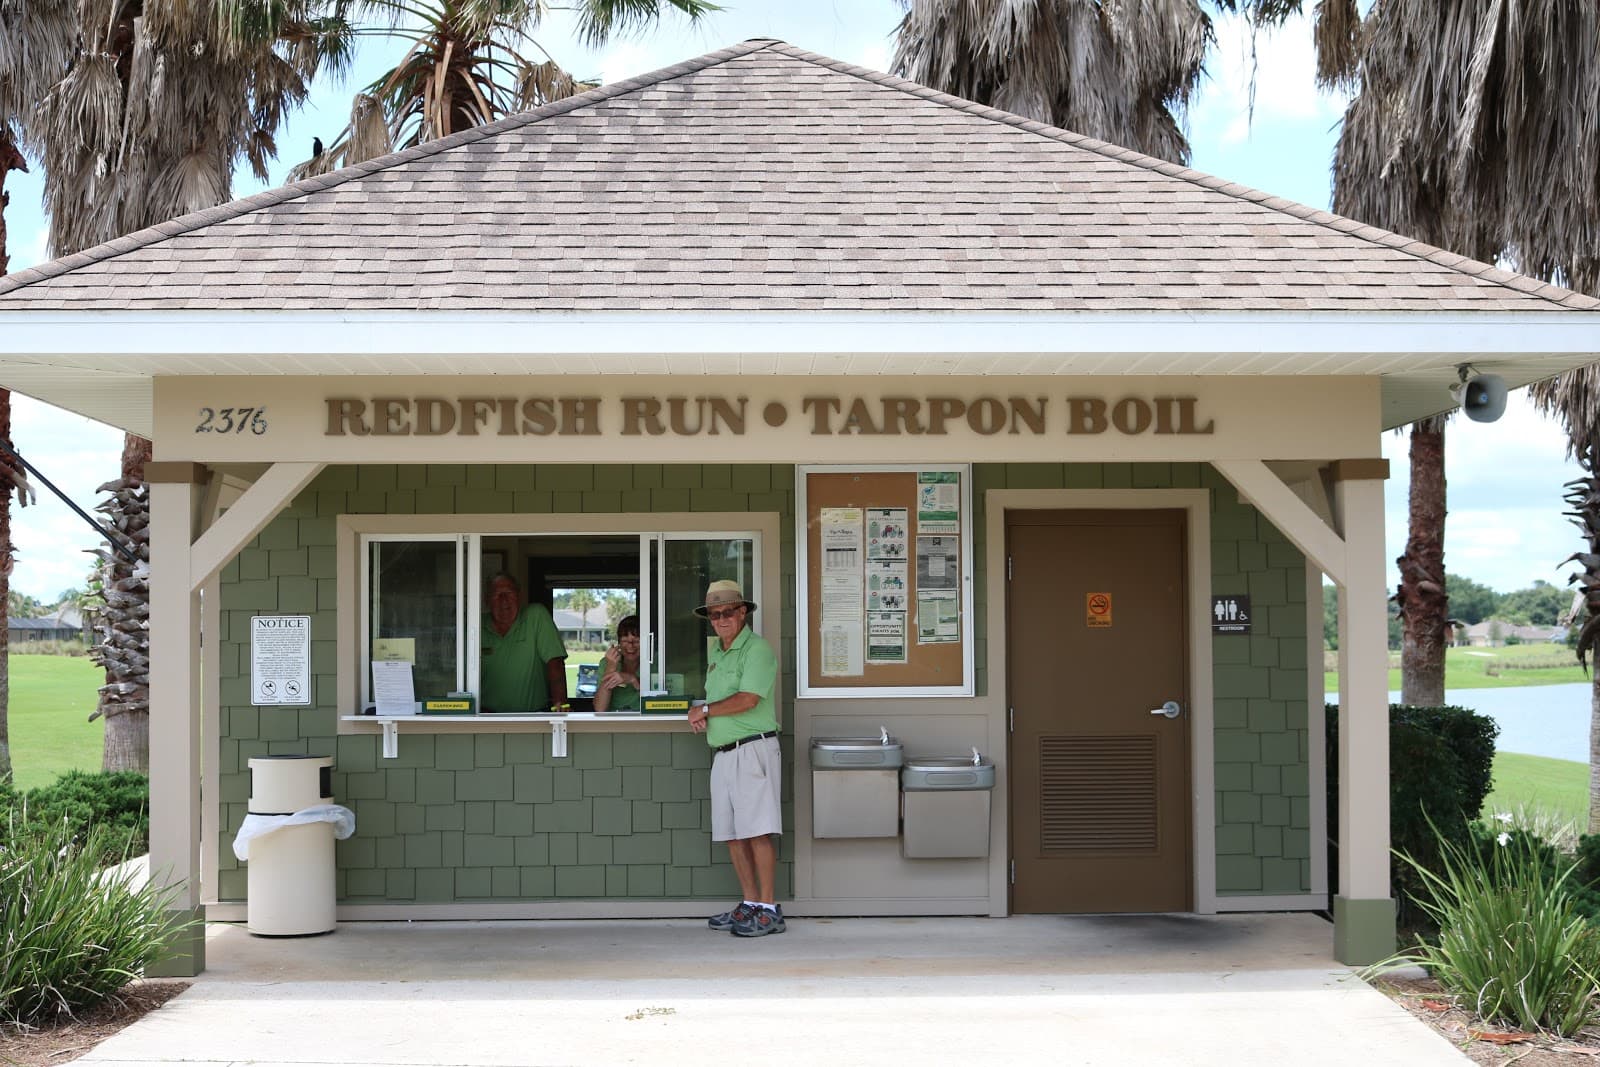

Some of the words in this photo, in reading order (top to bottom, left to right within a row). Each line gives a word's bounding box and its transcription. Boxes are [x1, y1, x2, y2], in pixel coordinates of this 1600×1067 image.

[195, 407, 268, 436] 2376
[324, 398, 602, 436] REDFISH
[620, 397, 747, 436] RUN
[802, 397, 1047, 435] TARPON
[1066, 397, 1215, 435] BOIL
[258, 619, 304, 628] NOTICE
